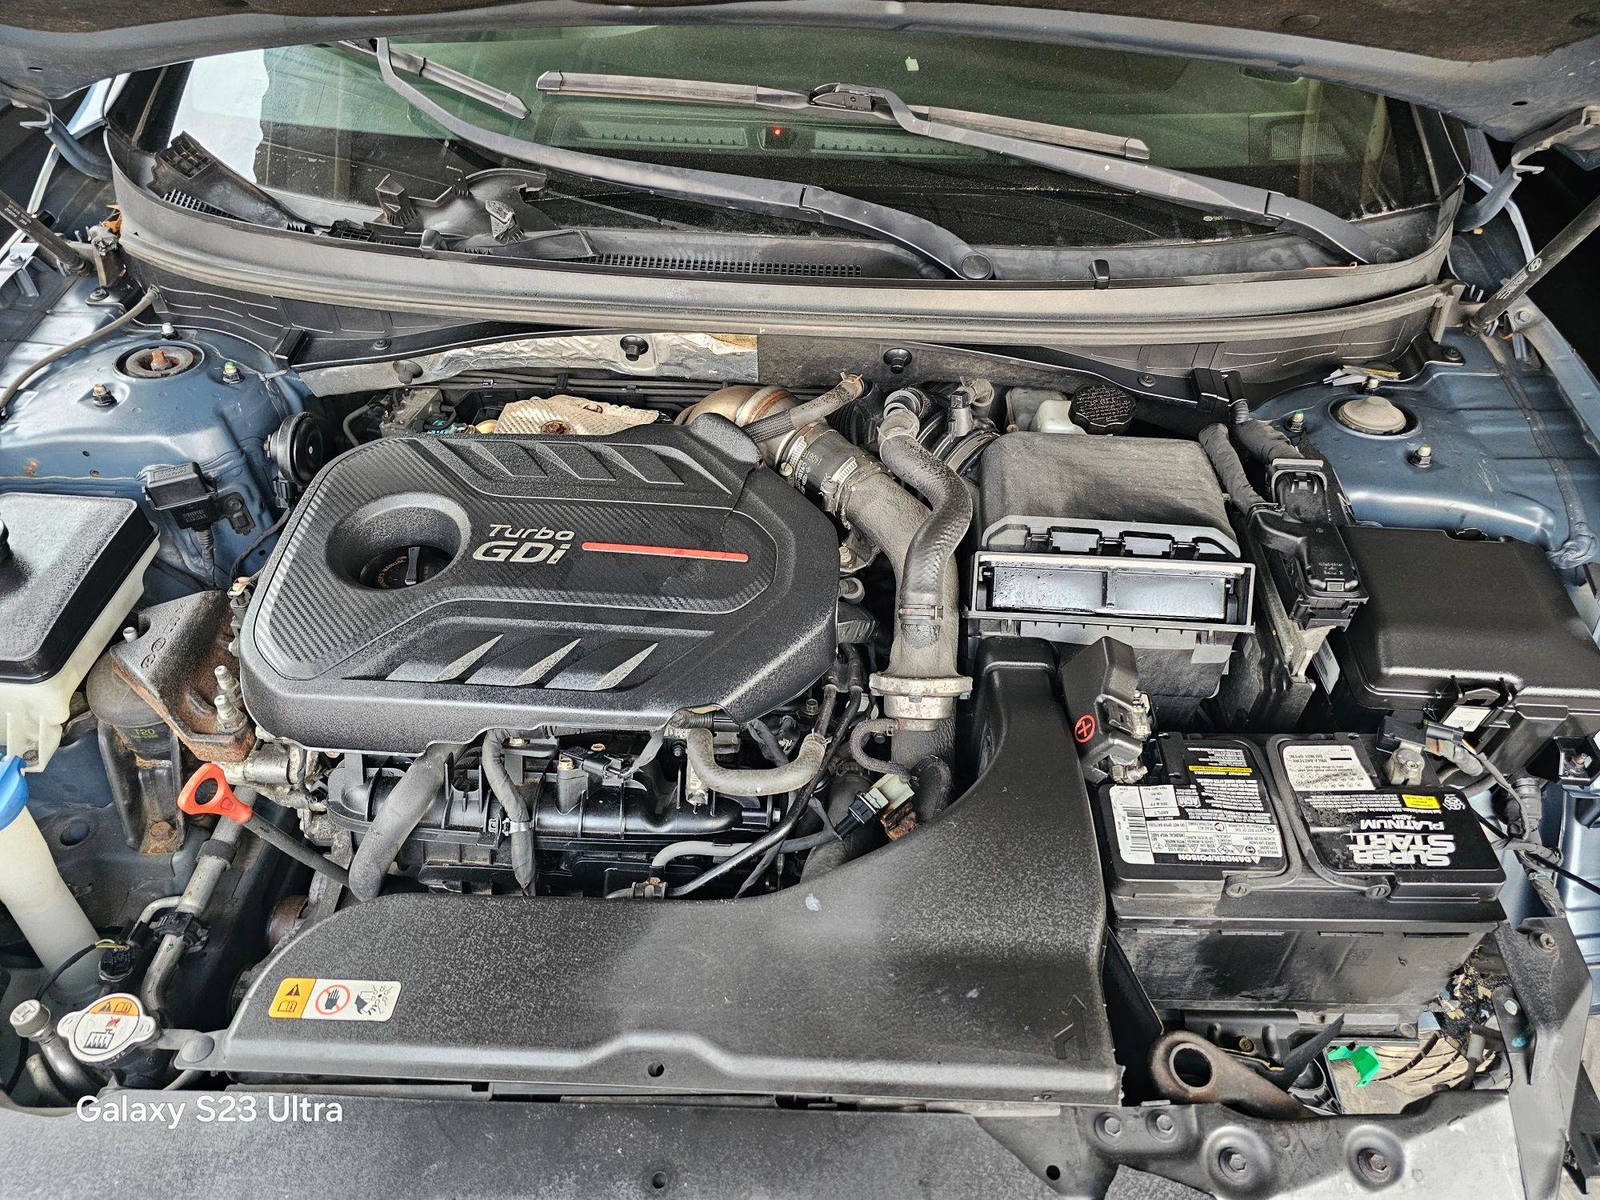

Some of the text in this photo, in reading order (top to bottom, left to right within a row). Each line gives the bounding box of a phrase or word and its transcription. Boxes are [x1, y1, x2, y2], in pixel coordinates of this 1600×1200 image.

[488, 523, 575, 541] Turbo
[472, 541, 573, 565] GDi
[1360, 818, 1445, 831] PLATINUM
[1348, 833, 1456, 852] START
[1178, 854, 1252, 863] DANGER/POISON
[1353, 849, 1451, 867] SUPER
